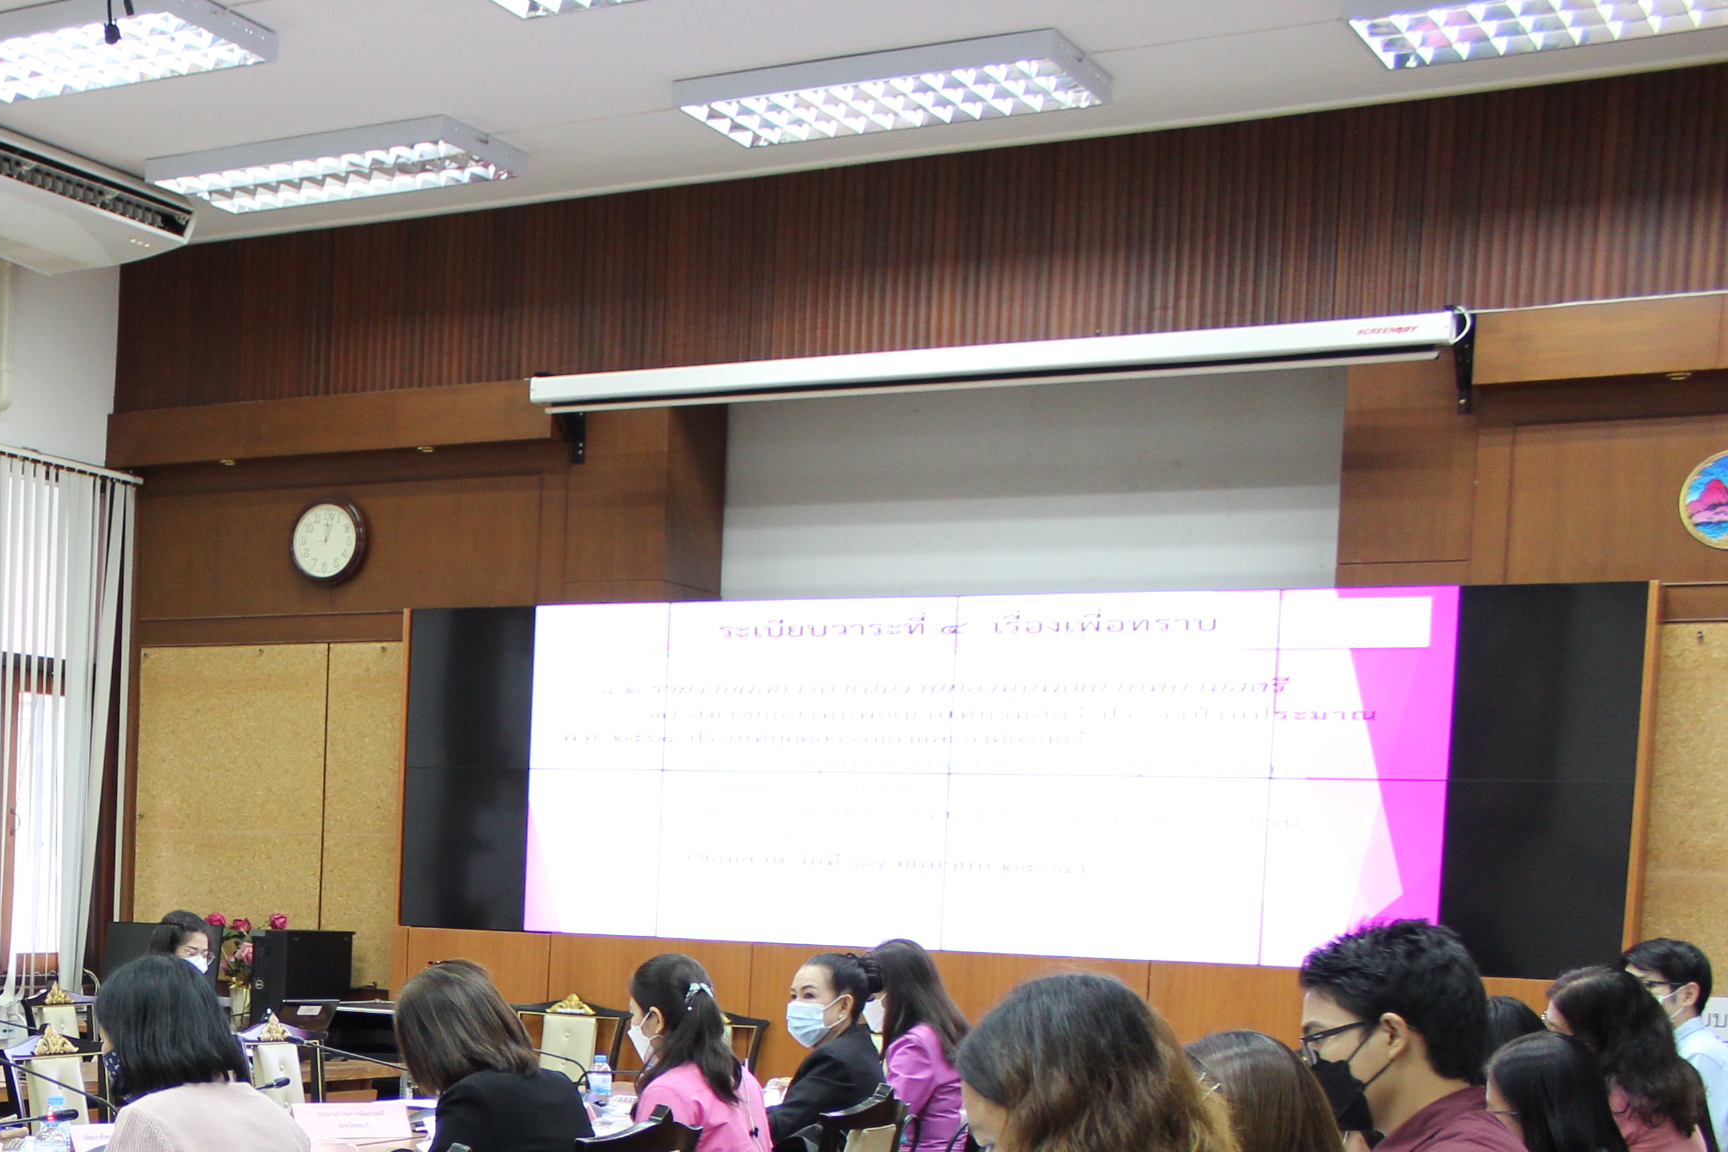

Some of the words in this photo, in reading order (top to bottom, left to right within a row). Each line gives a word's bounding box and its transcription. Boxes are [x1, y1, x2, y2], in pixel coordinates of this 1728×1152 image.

[719, 612, 925, 638] ระเบียบวาระที่
[941, 620, 968, 636] ๔
[994, 609, 1217, 635] เรื่องเพื่อทราบ
